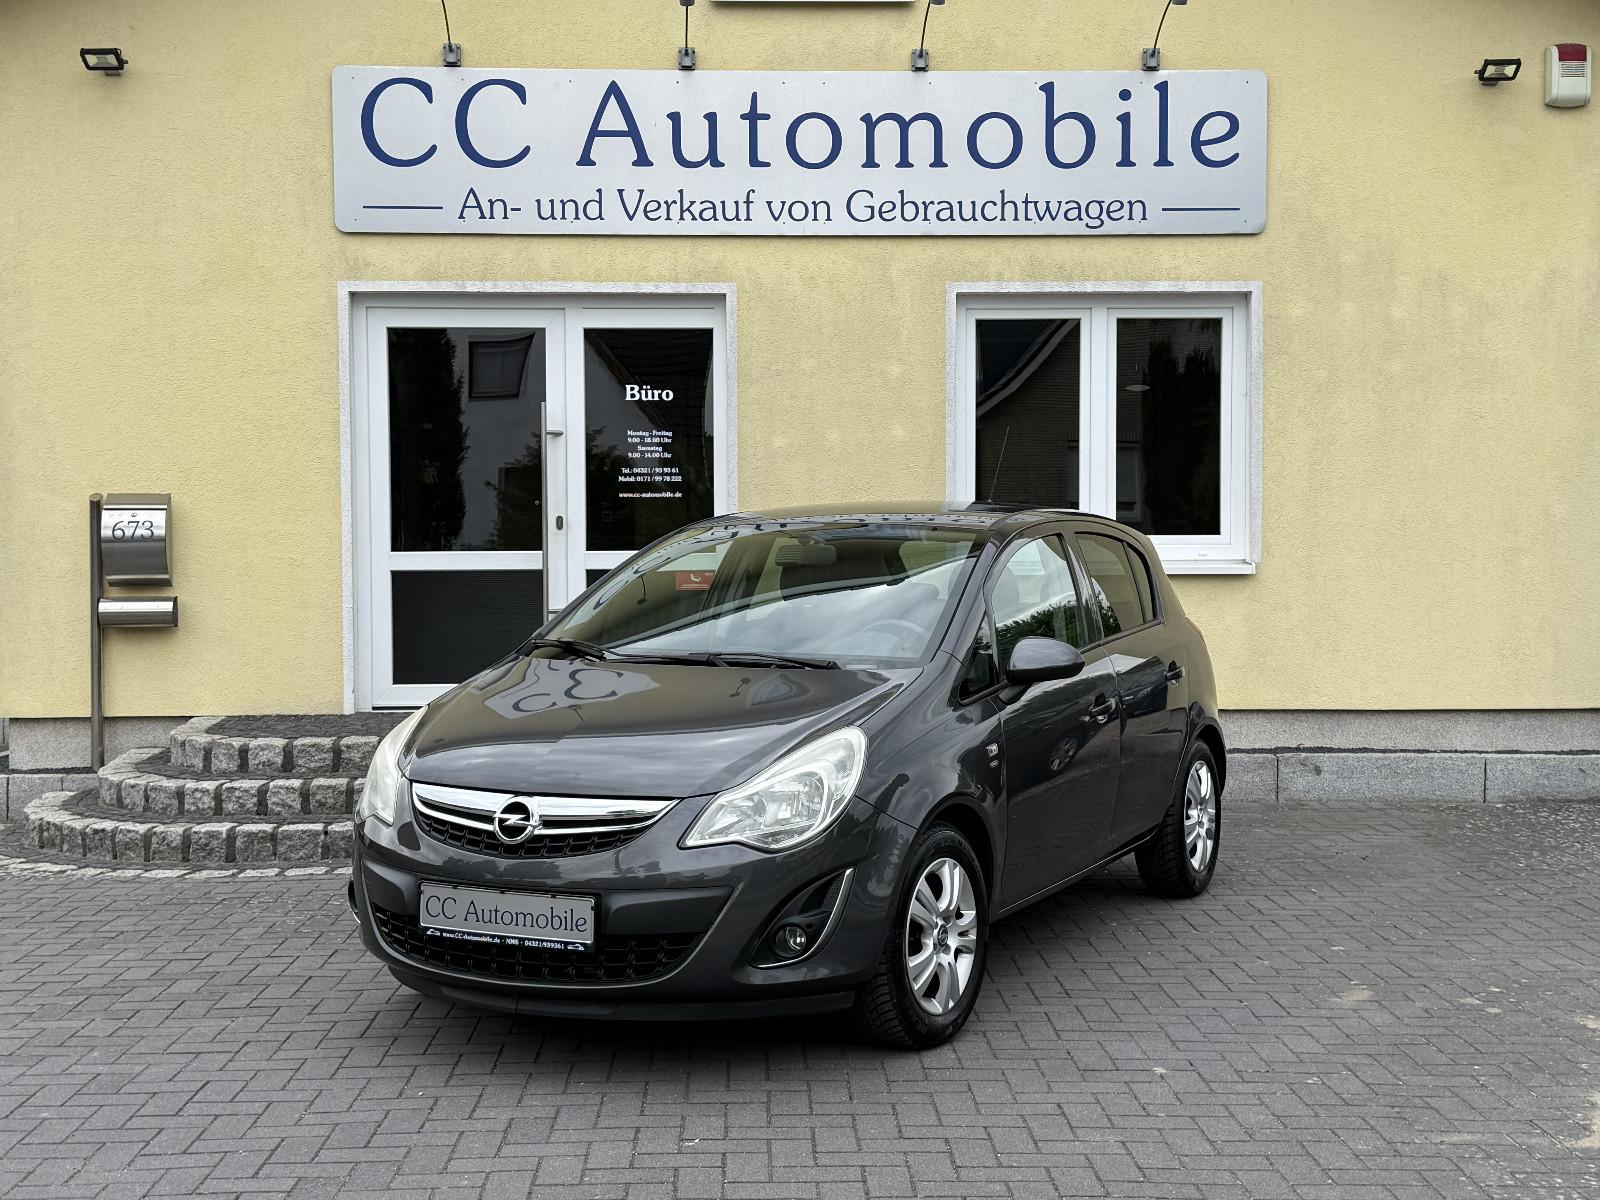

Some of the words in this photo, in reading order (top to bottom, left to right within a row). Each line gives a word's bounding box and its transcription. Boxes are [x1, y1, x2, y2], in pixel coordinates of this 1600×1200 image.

[360, 77, 531, 169] CC
[575, 79, 1240, 170] Automobile
[458, 186, 522, 221] An-
[534, 187, 605, 221] und
[616, 188, 756, 222] Verkauf
[765, 200, 833, 222] von
[845, 188, 1148, 230] Gebrauchtwagen
[624, 384, 675, 401] Büro
[111, 520, 155, 541] 673
[425, 895, 457, 920] CC
[463, 899, 588, 933] Automobile
[442, 932, 501, 944] www.CC-Automobile.de
[505, 938, 519, 946] NMS
[524, 940, 565, 950] 04321/939361
